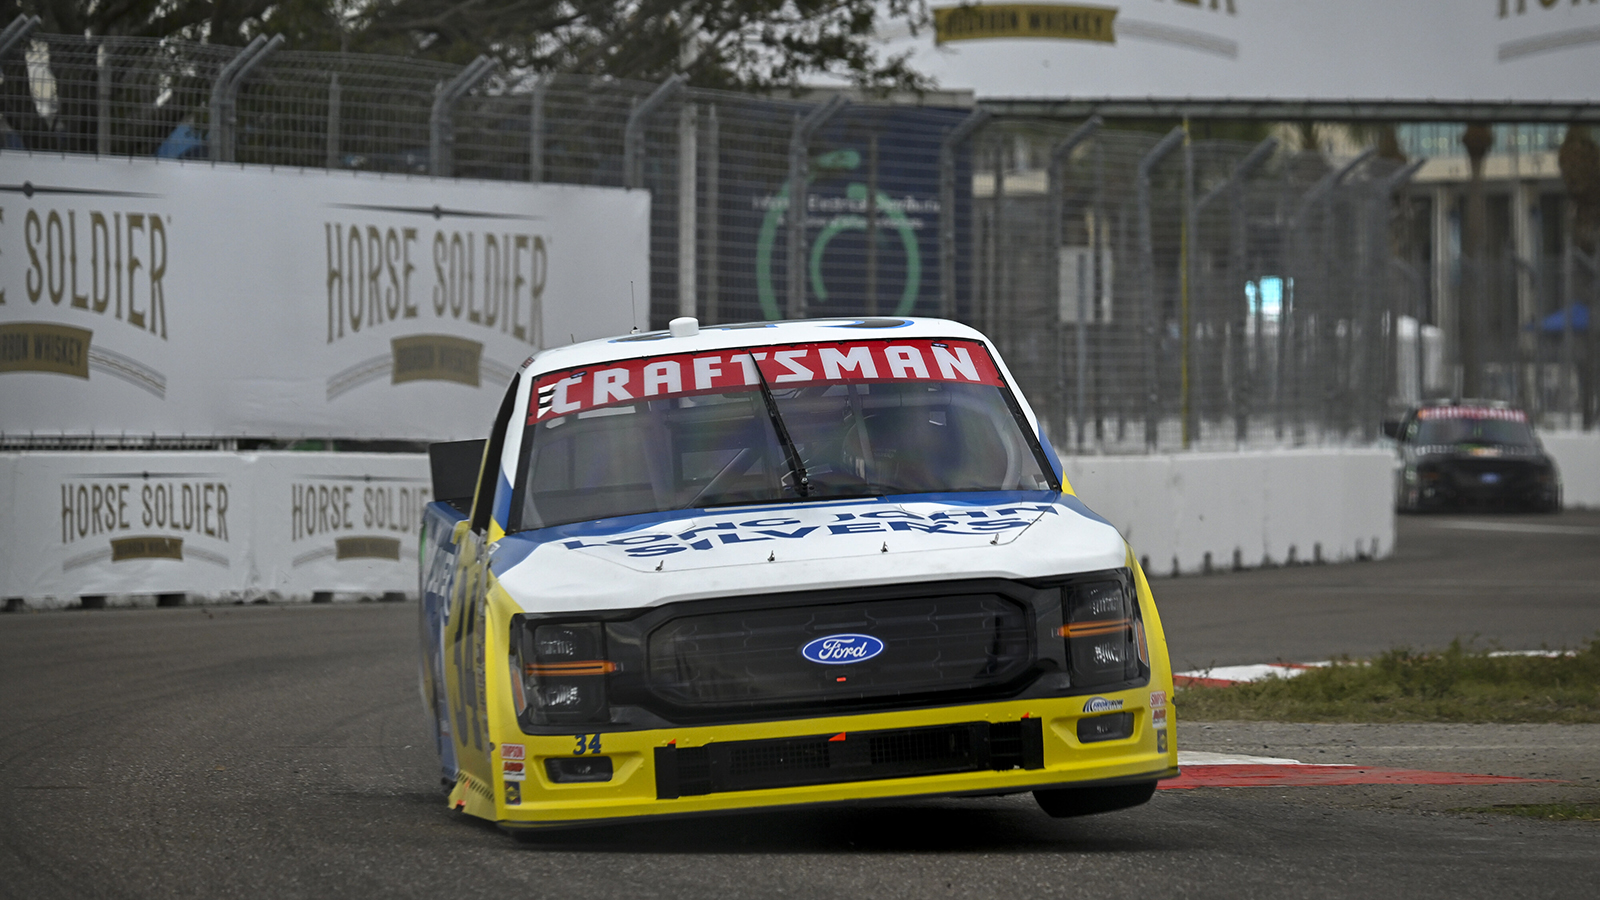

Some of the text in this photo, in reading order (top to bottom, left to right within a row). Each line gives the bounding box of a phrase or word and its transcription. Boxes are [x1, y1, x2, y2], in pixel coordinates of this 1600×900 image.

[25, 208, 168, 341] SOLDIER
[325, 222, 548, 350] HORSE SOLDIER
[549, 344, 981, 415] CRAFTSMAN
[61, 483, 229, 544] HORSE SOLDIER
[292, 484, 353, 541] HORSE
[563, 505, 1059, 550] LONG JOHN
[818, 638, 867, 659] Ford
[573, 733, 602, 755] 34
